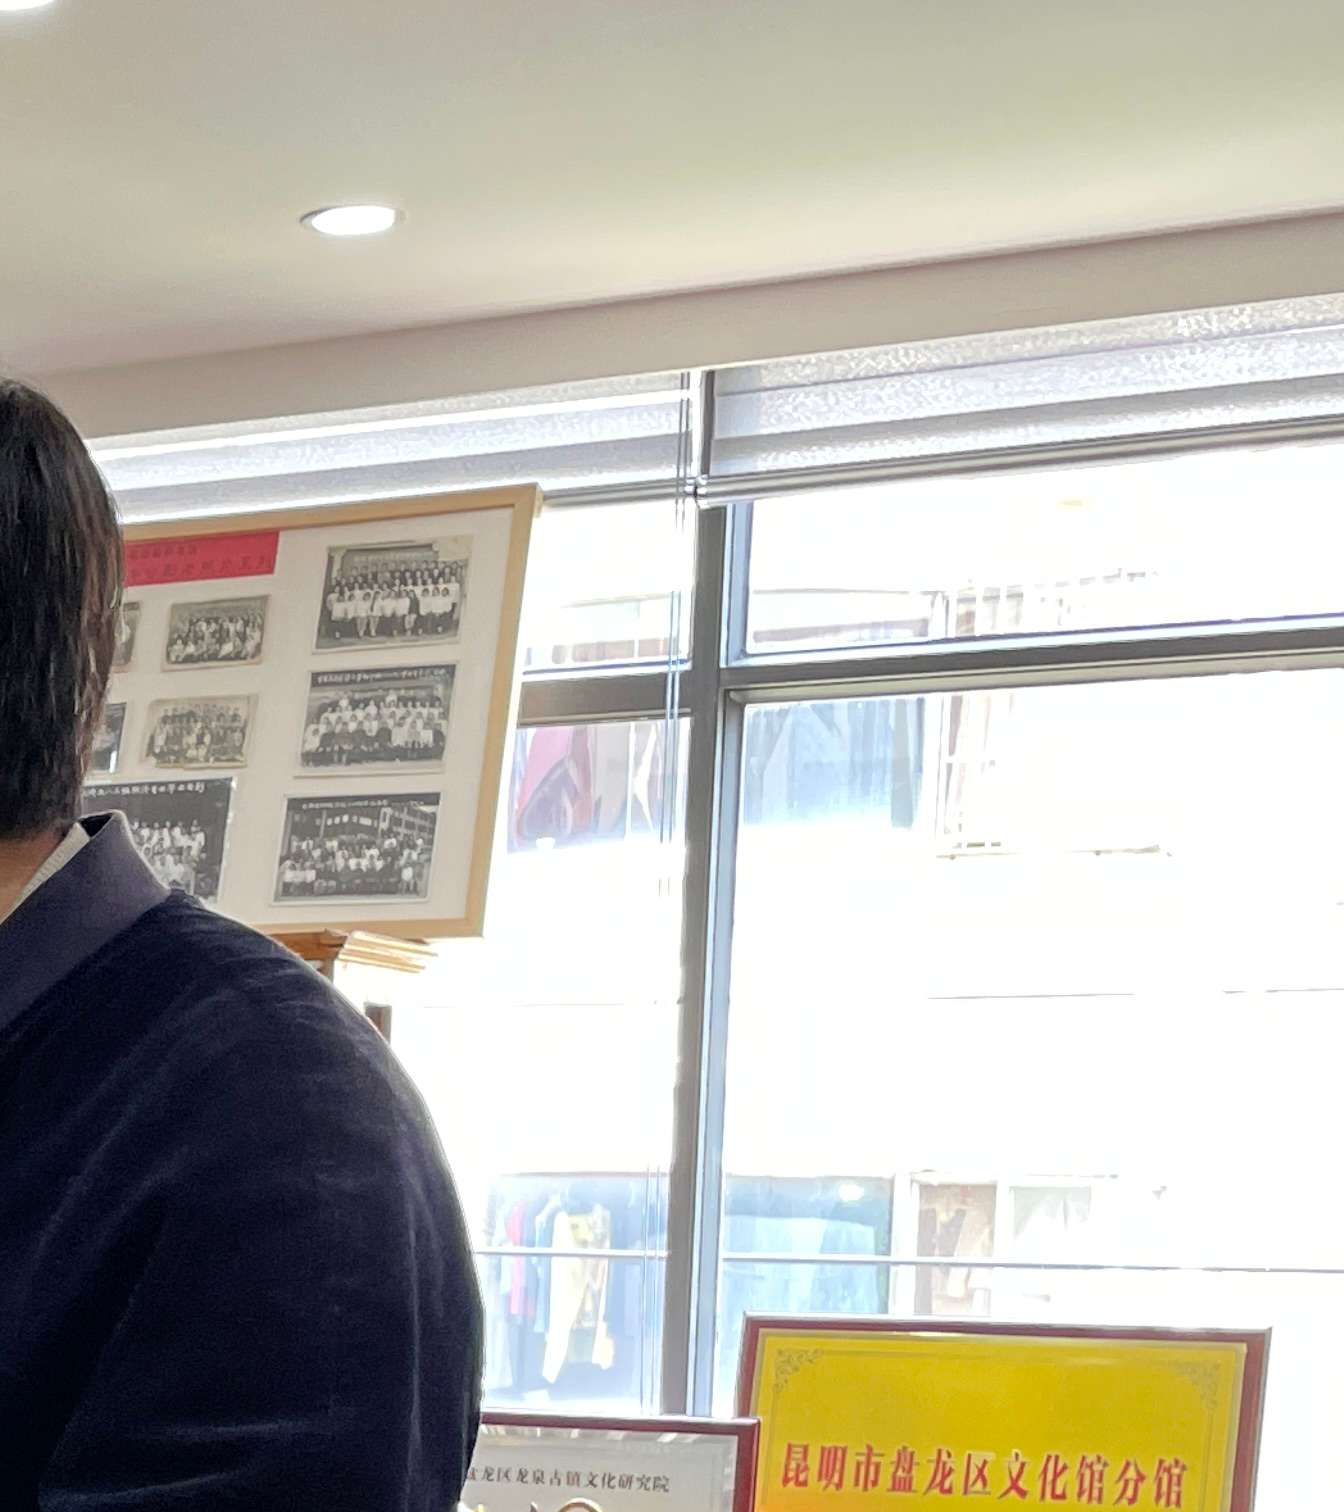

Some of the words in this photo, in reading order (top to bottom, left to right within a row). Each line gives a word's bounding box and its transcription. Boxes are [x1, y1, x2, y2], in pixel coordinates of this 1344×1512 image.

[780, 1442, 1188, 1510] 昆明市盘龙区文化馆分馆
